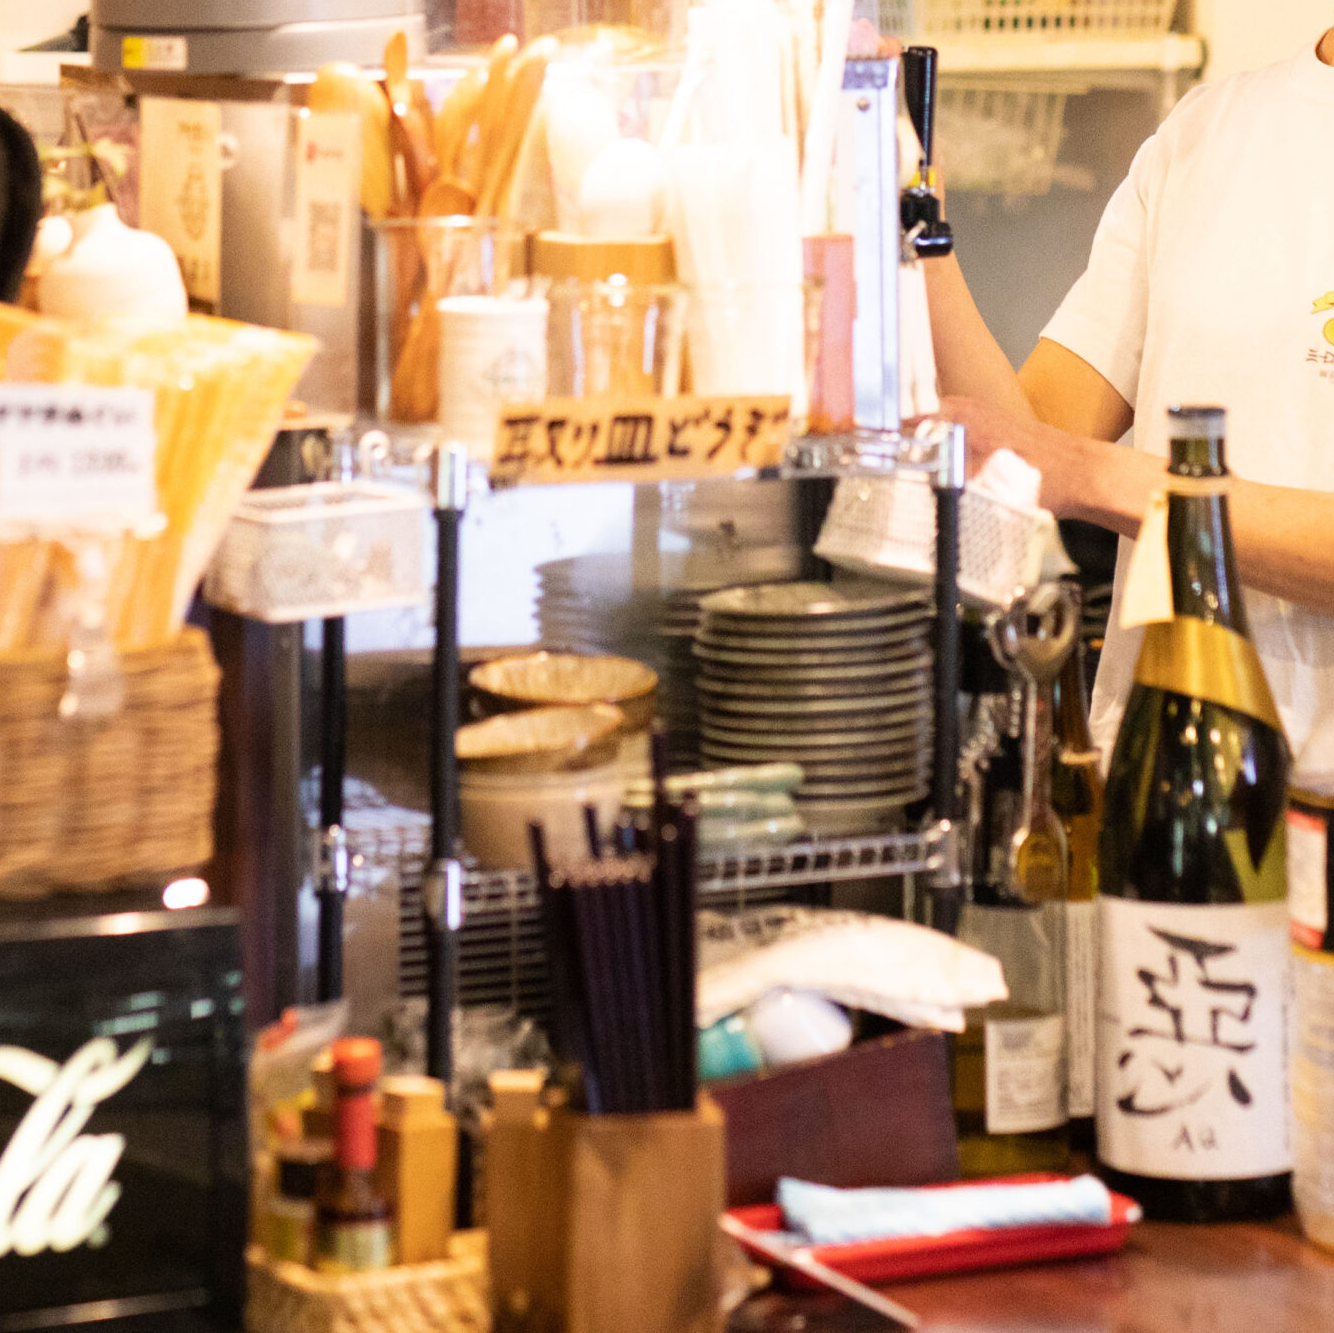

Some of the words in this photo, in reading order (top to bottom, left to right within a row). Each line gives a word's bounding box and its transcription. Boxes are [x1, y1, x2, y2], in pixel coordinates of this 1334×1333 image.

[496, 406, 791, 468] 取り皿どうぞ
